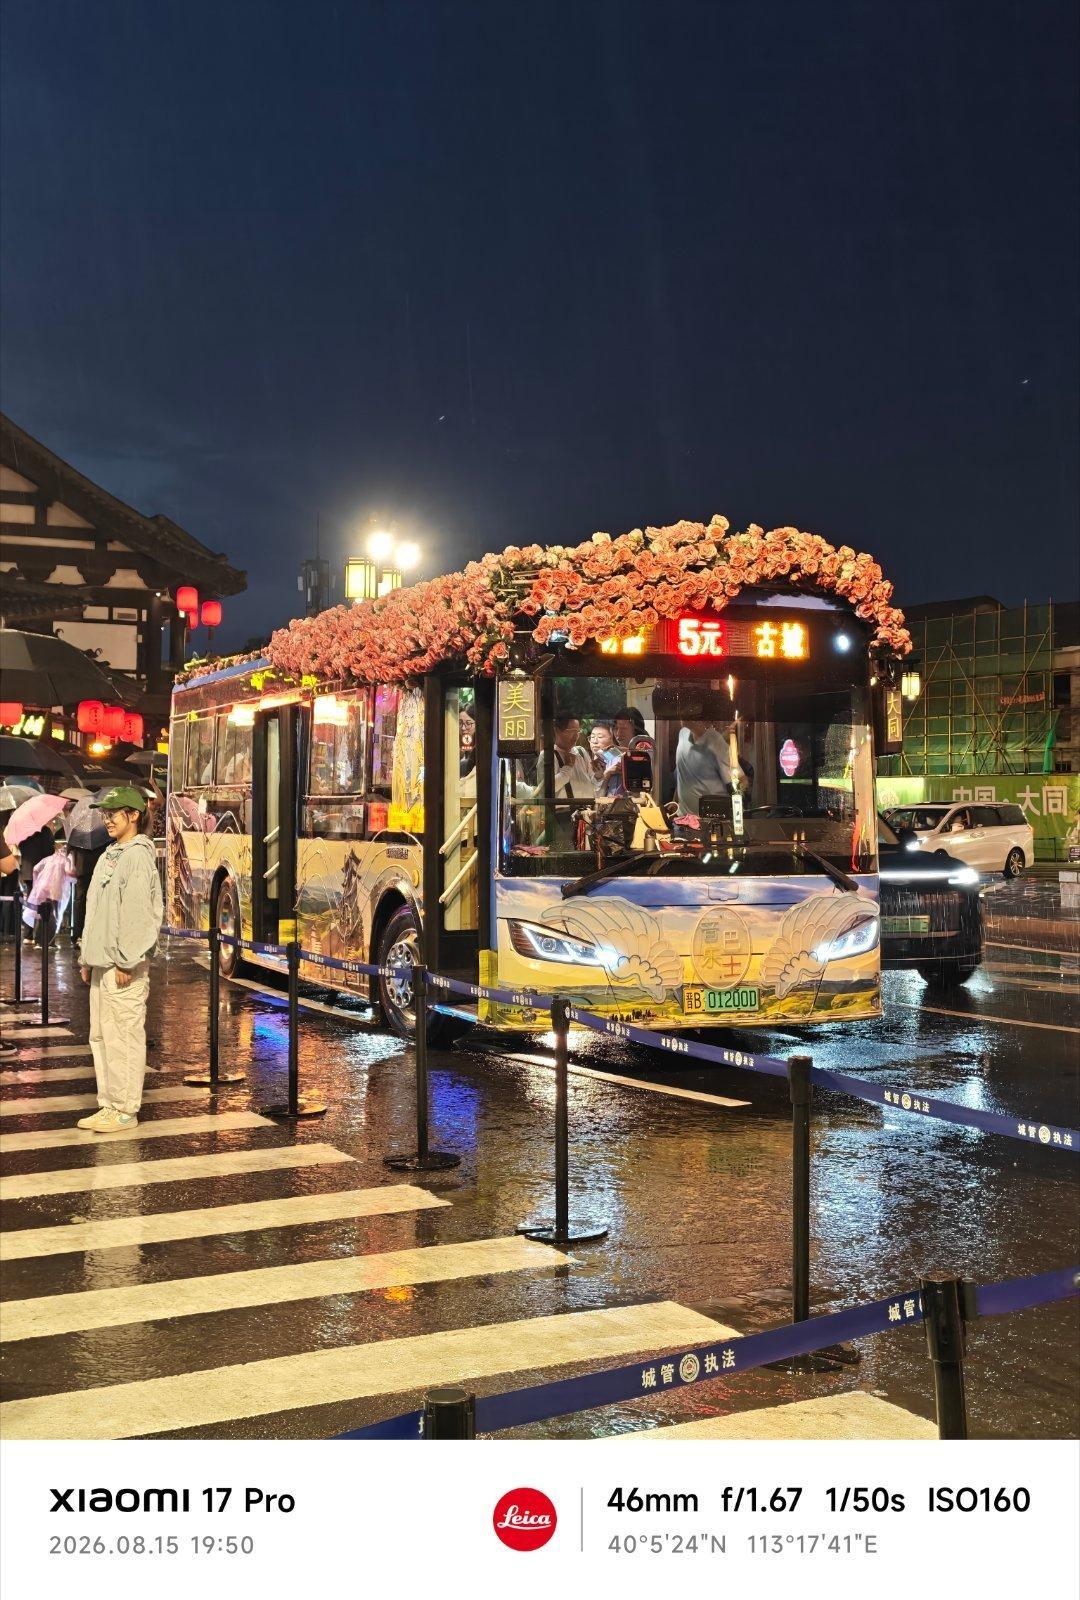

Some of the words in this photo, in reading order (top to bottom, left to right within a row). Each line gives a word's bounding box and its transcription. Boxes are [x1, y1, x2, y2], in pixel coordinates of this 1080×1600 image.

[679, 618, 723, 656] 5元
[502, 682, 532, 737] 美丽
[887, 692, 901, 738] 大同
[888, 1299, 915, 1322] 城管
[642, 1363, 674, 1388] 城管
[704, 1348, 736, 1373] 执法
